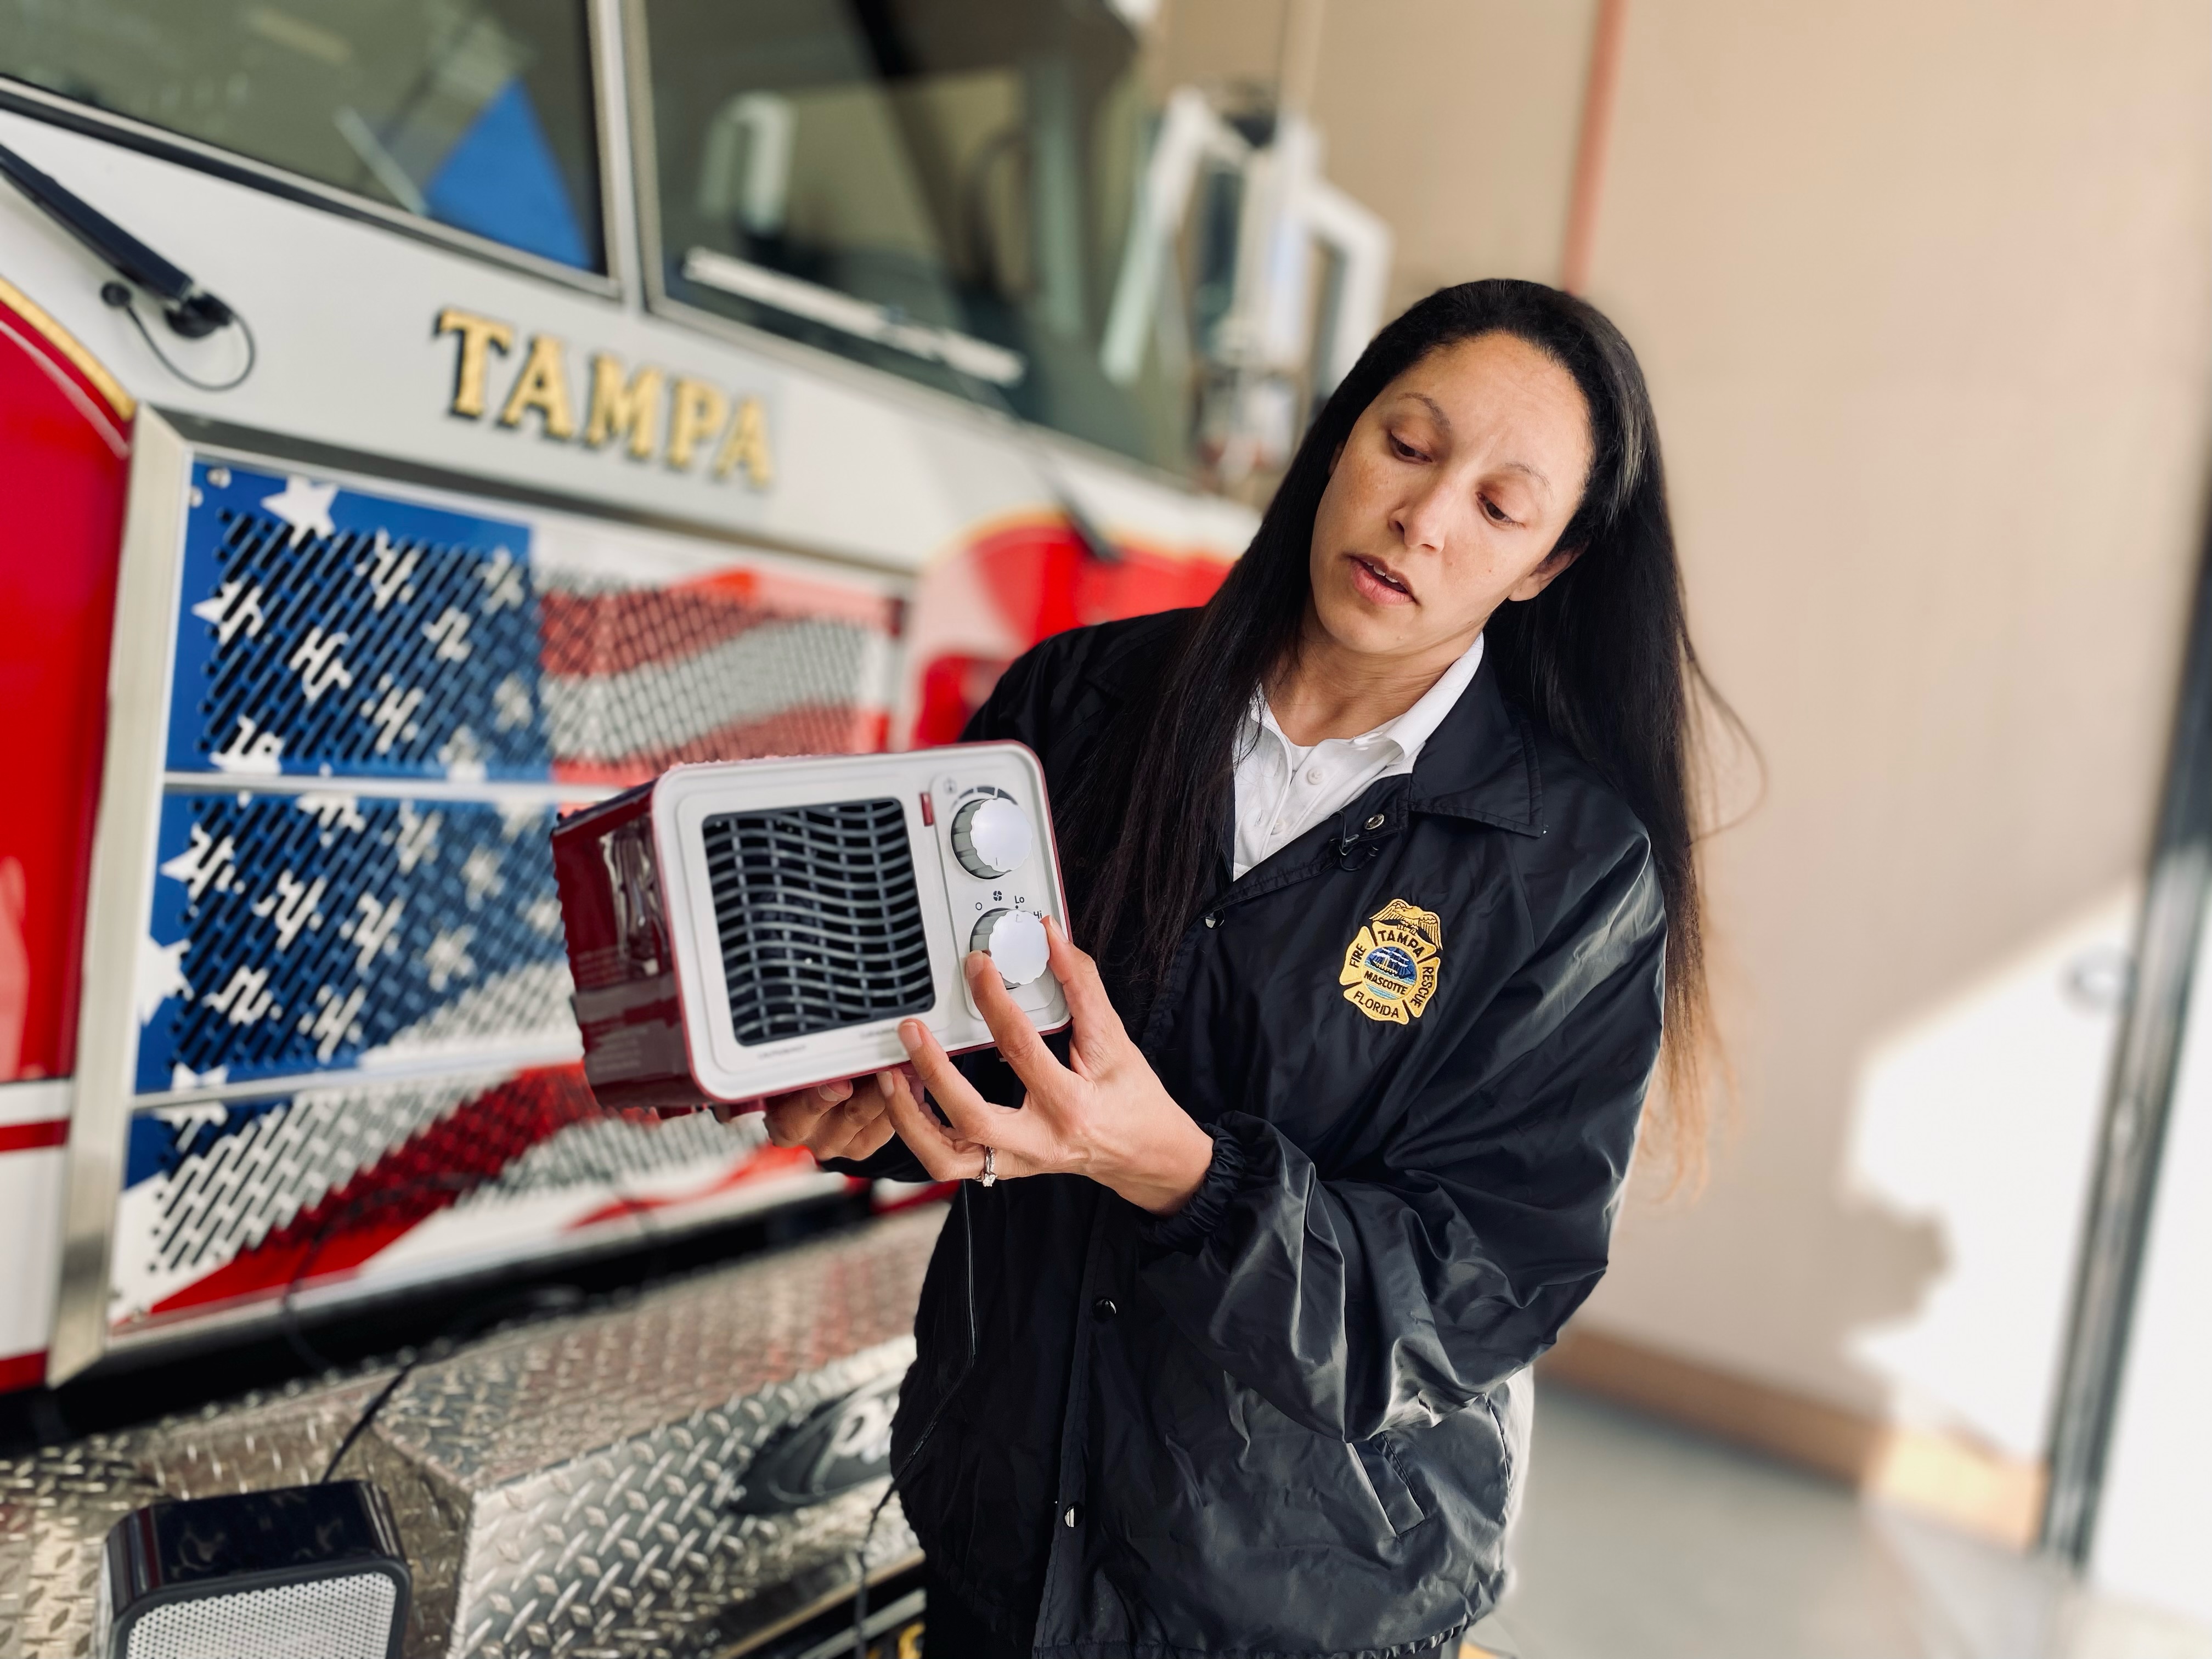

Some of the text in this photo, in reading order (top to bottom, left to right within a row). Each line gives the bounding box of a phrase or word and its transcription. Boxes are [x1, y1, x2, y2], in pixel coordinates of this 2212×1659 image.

[434, 307, 772, 488] TAMPA
[1014, 895, 1025, 904] Lo
[1349, 943, 1367, 968] FIRE
[1378, 930, 1425, 958] TAMPA
[1364, 970, 1408, 995] MASCOTTE
[1409, 966, 1434, 1008] RESCUE
[1353, 990, 1399, 1018] FLORIDA
